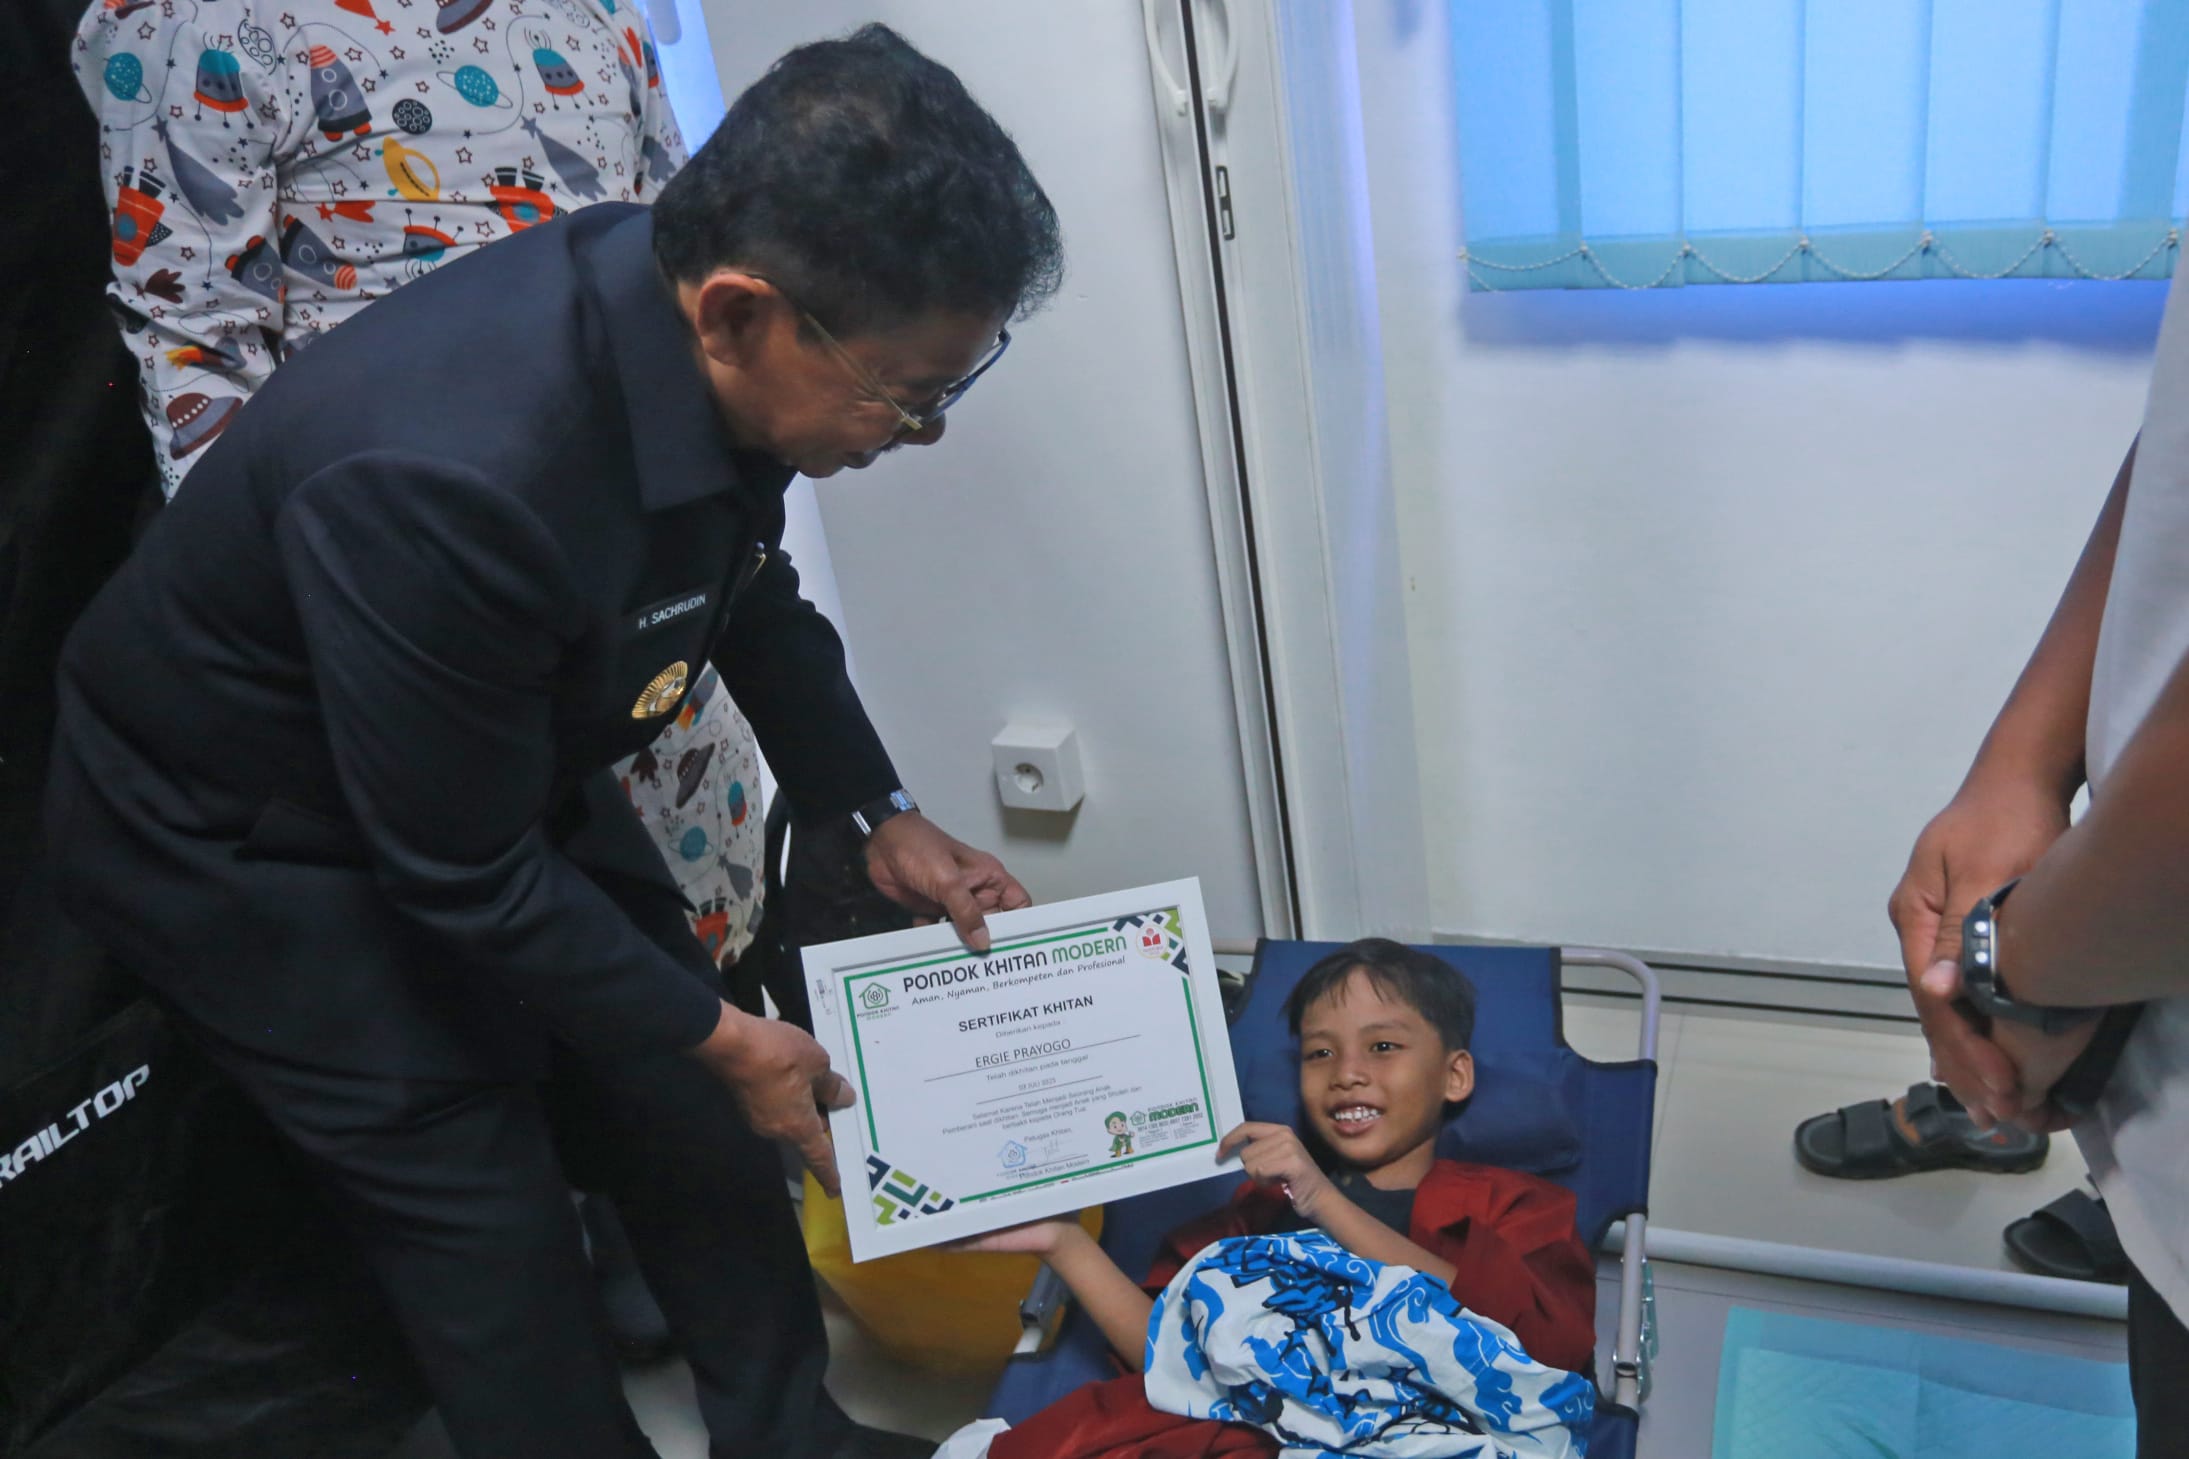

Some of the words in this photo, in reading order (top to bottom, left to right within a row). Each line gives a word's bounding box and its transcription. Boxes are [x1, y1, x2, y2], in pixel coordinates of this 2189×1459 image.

[651, 593, 706, 624] SACHRUDIN
[903, 964, 979, 992] PONDOK
[984, 951, 1047, 977] KHITAN
[1052, 936, 1127, 964] MODERN
[911, 993, 944, 1006] Aman,
[947, 985, 989, 1000] Nyaman,
[993, 972, 1053, 989] Berkompeten
[1057, 967, 1074, 977] dan
[1077, 955, 1125, 973] Profesional
[958, 1006, 1038, 1032] SERTIFIKAT
[1043, 995, 1094, 1015] KHITAN
[975, 1051, 1011, 1068] ERGIE
[1013, 1038, 1071, 1060] PRAYOGO
